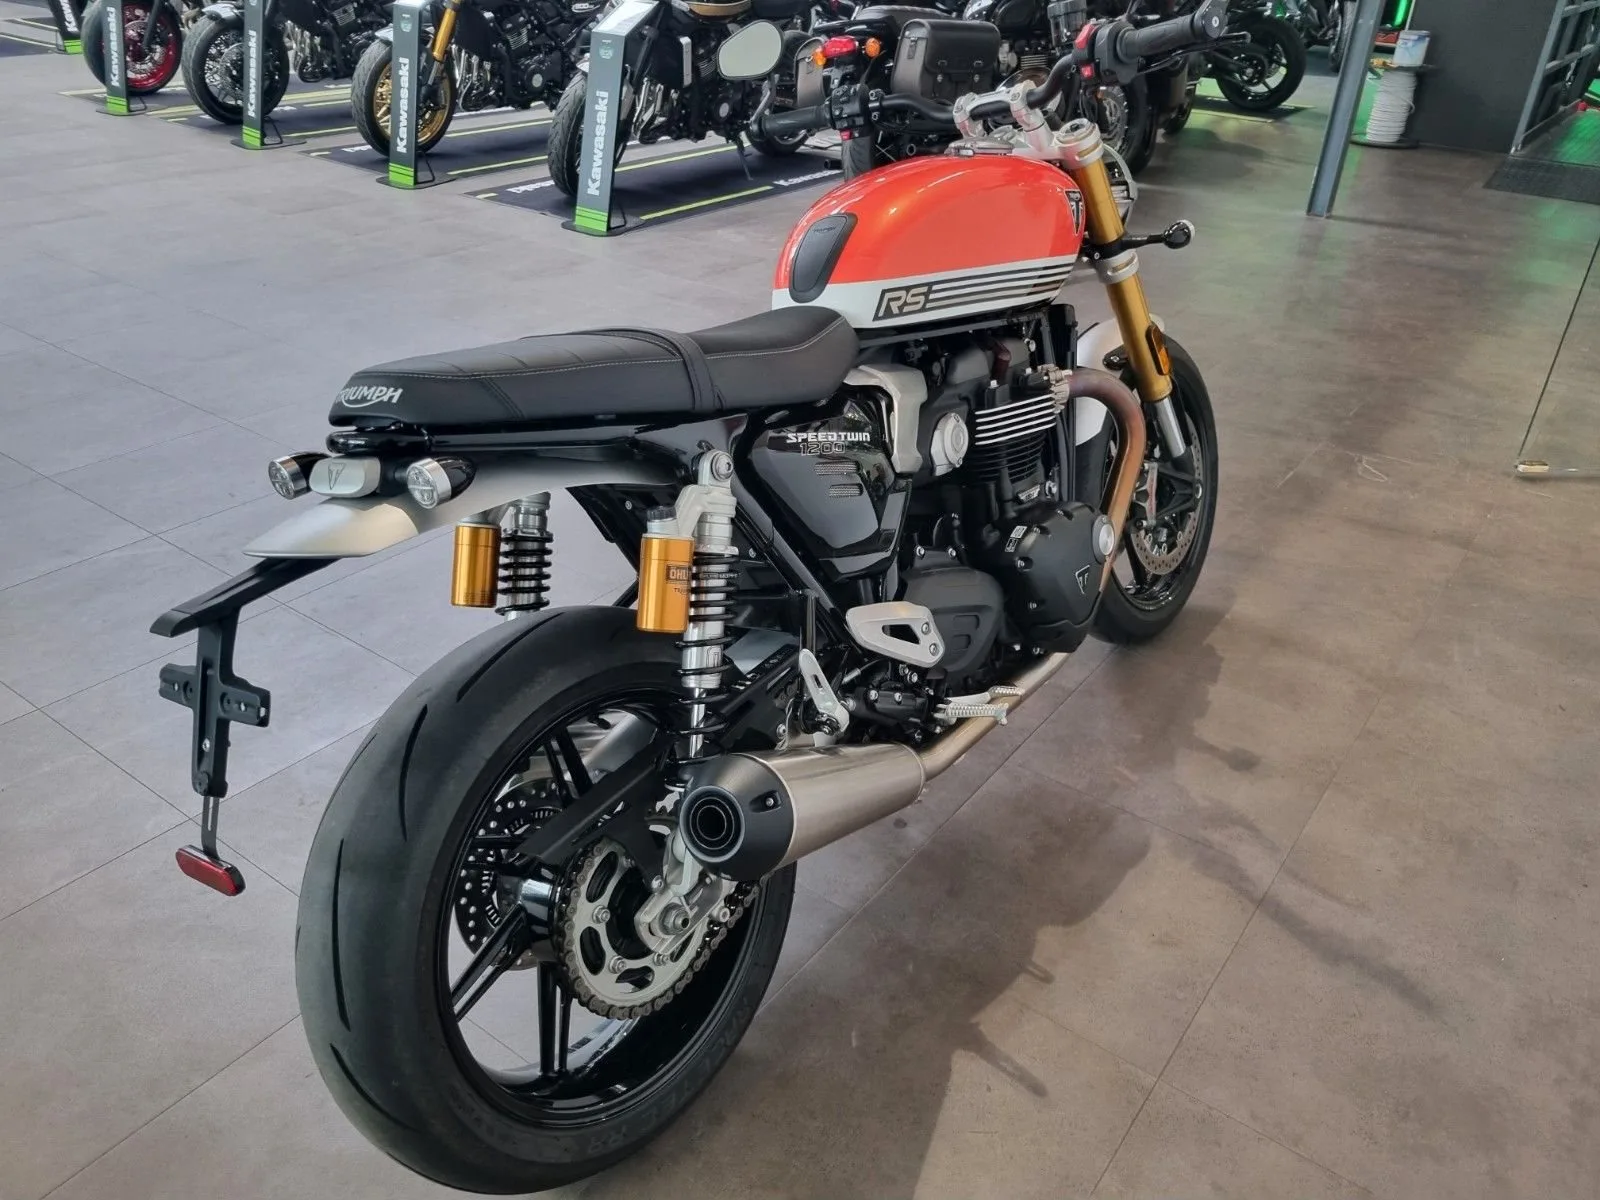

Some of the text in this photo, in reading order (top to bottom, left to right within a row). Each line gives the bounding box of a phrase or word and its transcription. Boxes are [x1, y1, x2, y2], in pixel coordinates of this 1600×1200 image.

[106, 6, 120, 87] Kawasaki
[247, 29, 257, 118] Kawasaki
[396, 56, 410, 153] Kawasaki
[587, 90, 609, 196] Kawasaki
[878, 286, 928, 317] RS
[335, 385, 403, 408] RIUMPH
[786, 431, 871, 443] SPEED TWIN
[800, 441, 846, 456] 1200
